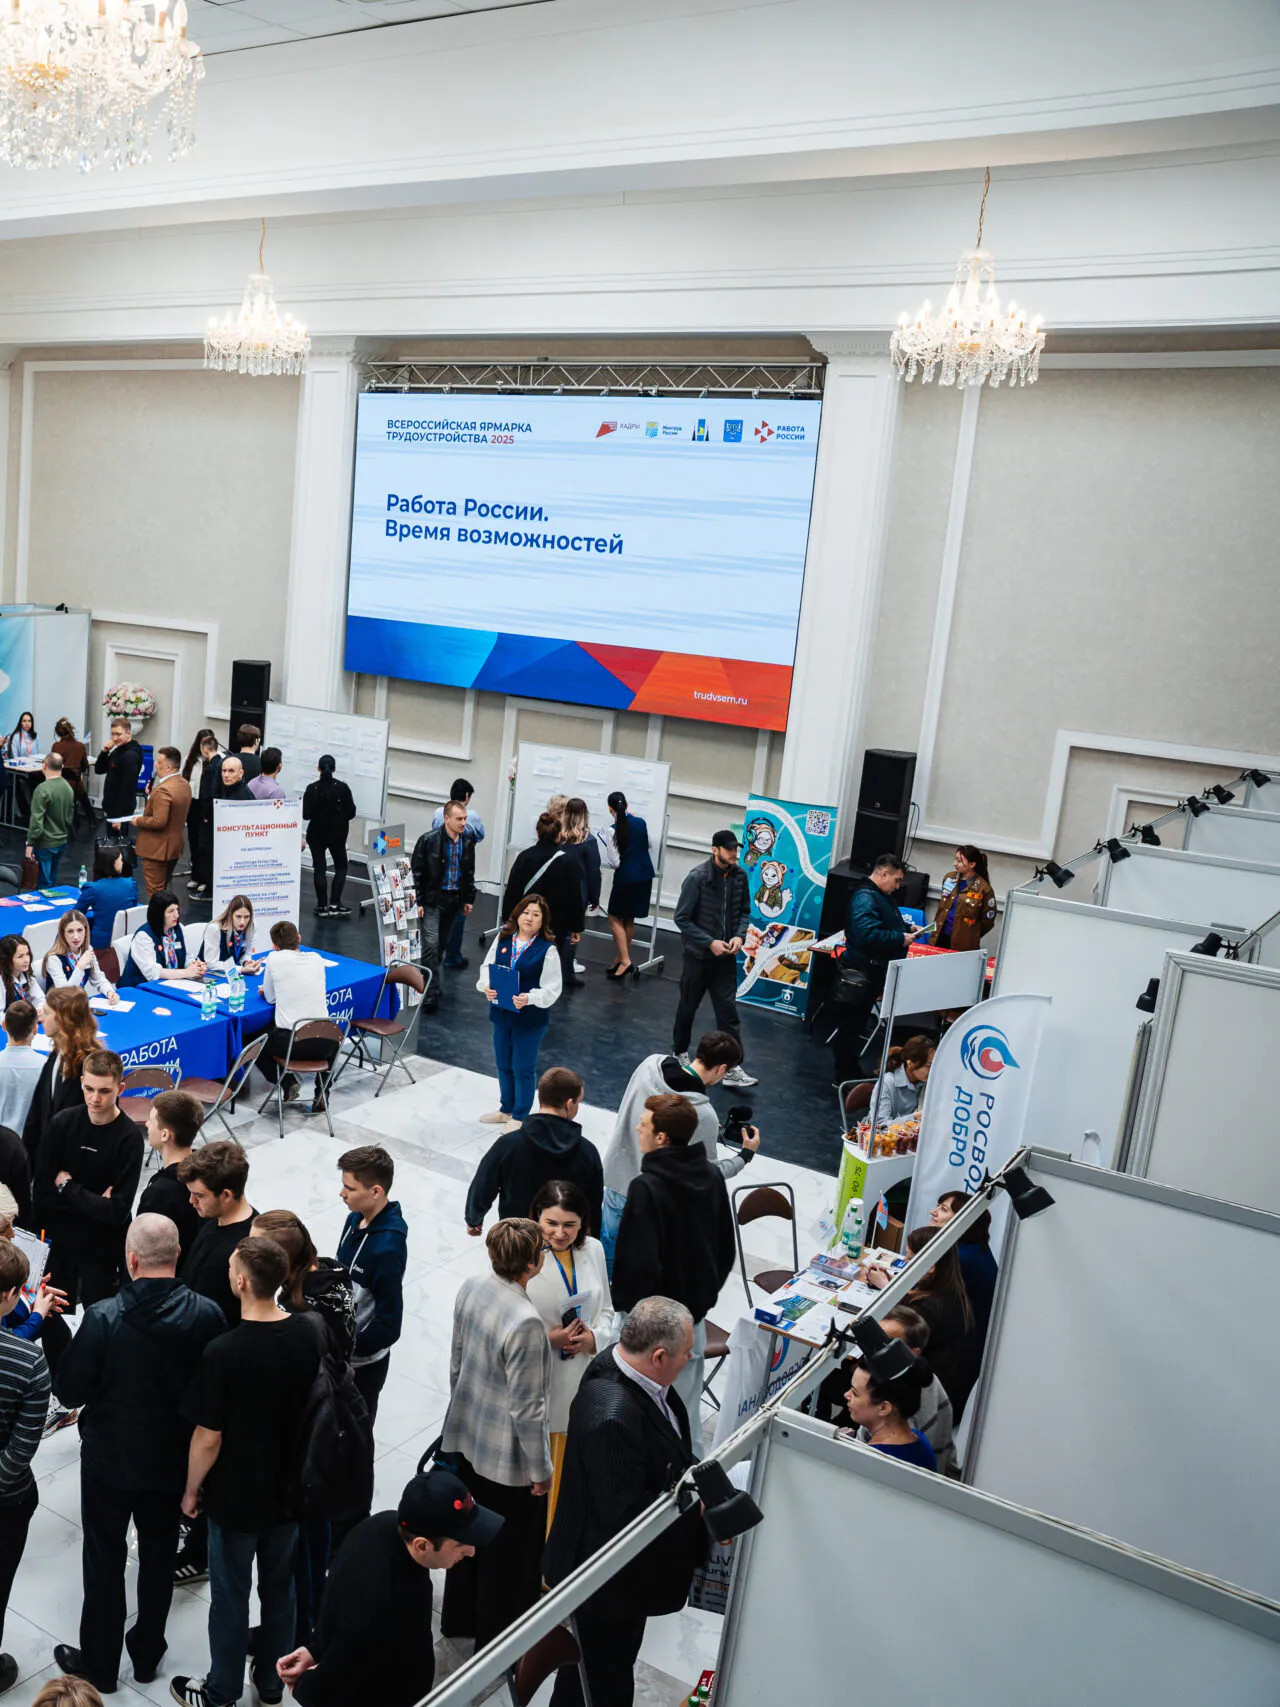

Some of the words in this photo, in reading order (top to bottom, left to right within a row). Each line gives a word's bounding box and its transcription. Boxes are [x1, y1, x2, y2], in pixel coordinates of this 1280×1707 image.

[387, 418, 477, 431] ВСЕРОССИЙСКАЯ
[479, 422, 532, 433] ЯРМАРКА
[777, 425, 805, 433] РАБОТА
[386, 431, 488, 443] ТРУДОУСТРОЙСТВА
[491, 435, 514, 444] 2025
[776, 433, 805, 441] РОССИИ
[386, 494, 457, 515] Работа
[464, 499, 549, 522] России.
[385, 519, 451, 542] Время
[457, 528, 624, 554] возможностей
[693, 690, 748, 705] trudvsem.ru
[217, 822, 298, 832] КОНСУЛЬТАЦИОННЫЙ
[120, 1036, 178, 1067] РАБОТА
[949, 1085, 973, 1167] ДОБРО
